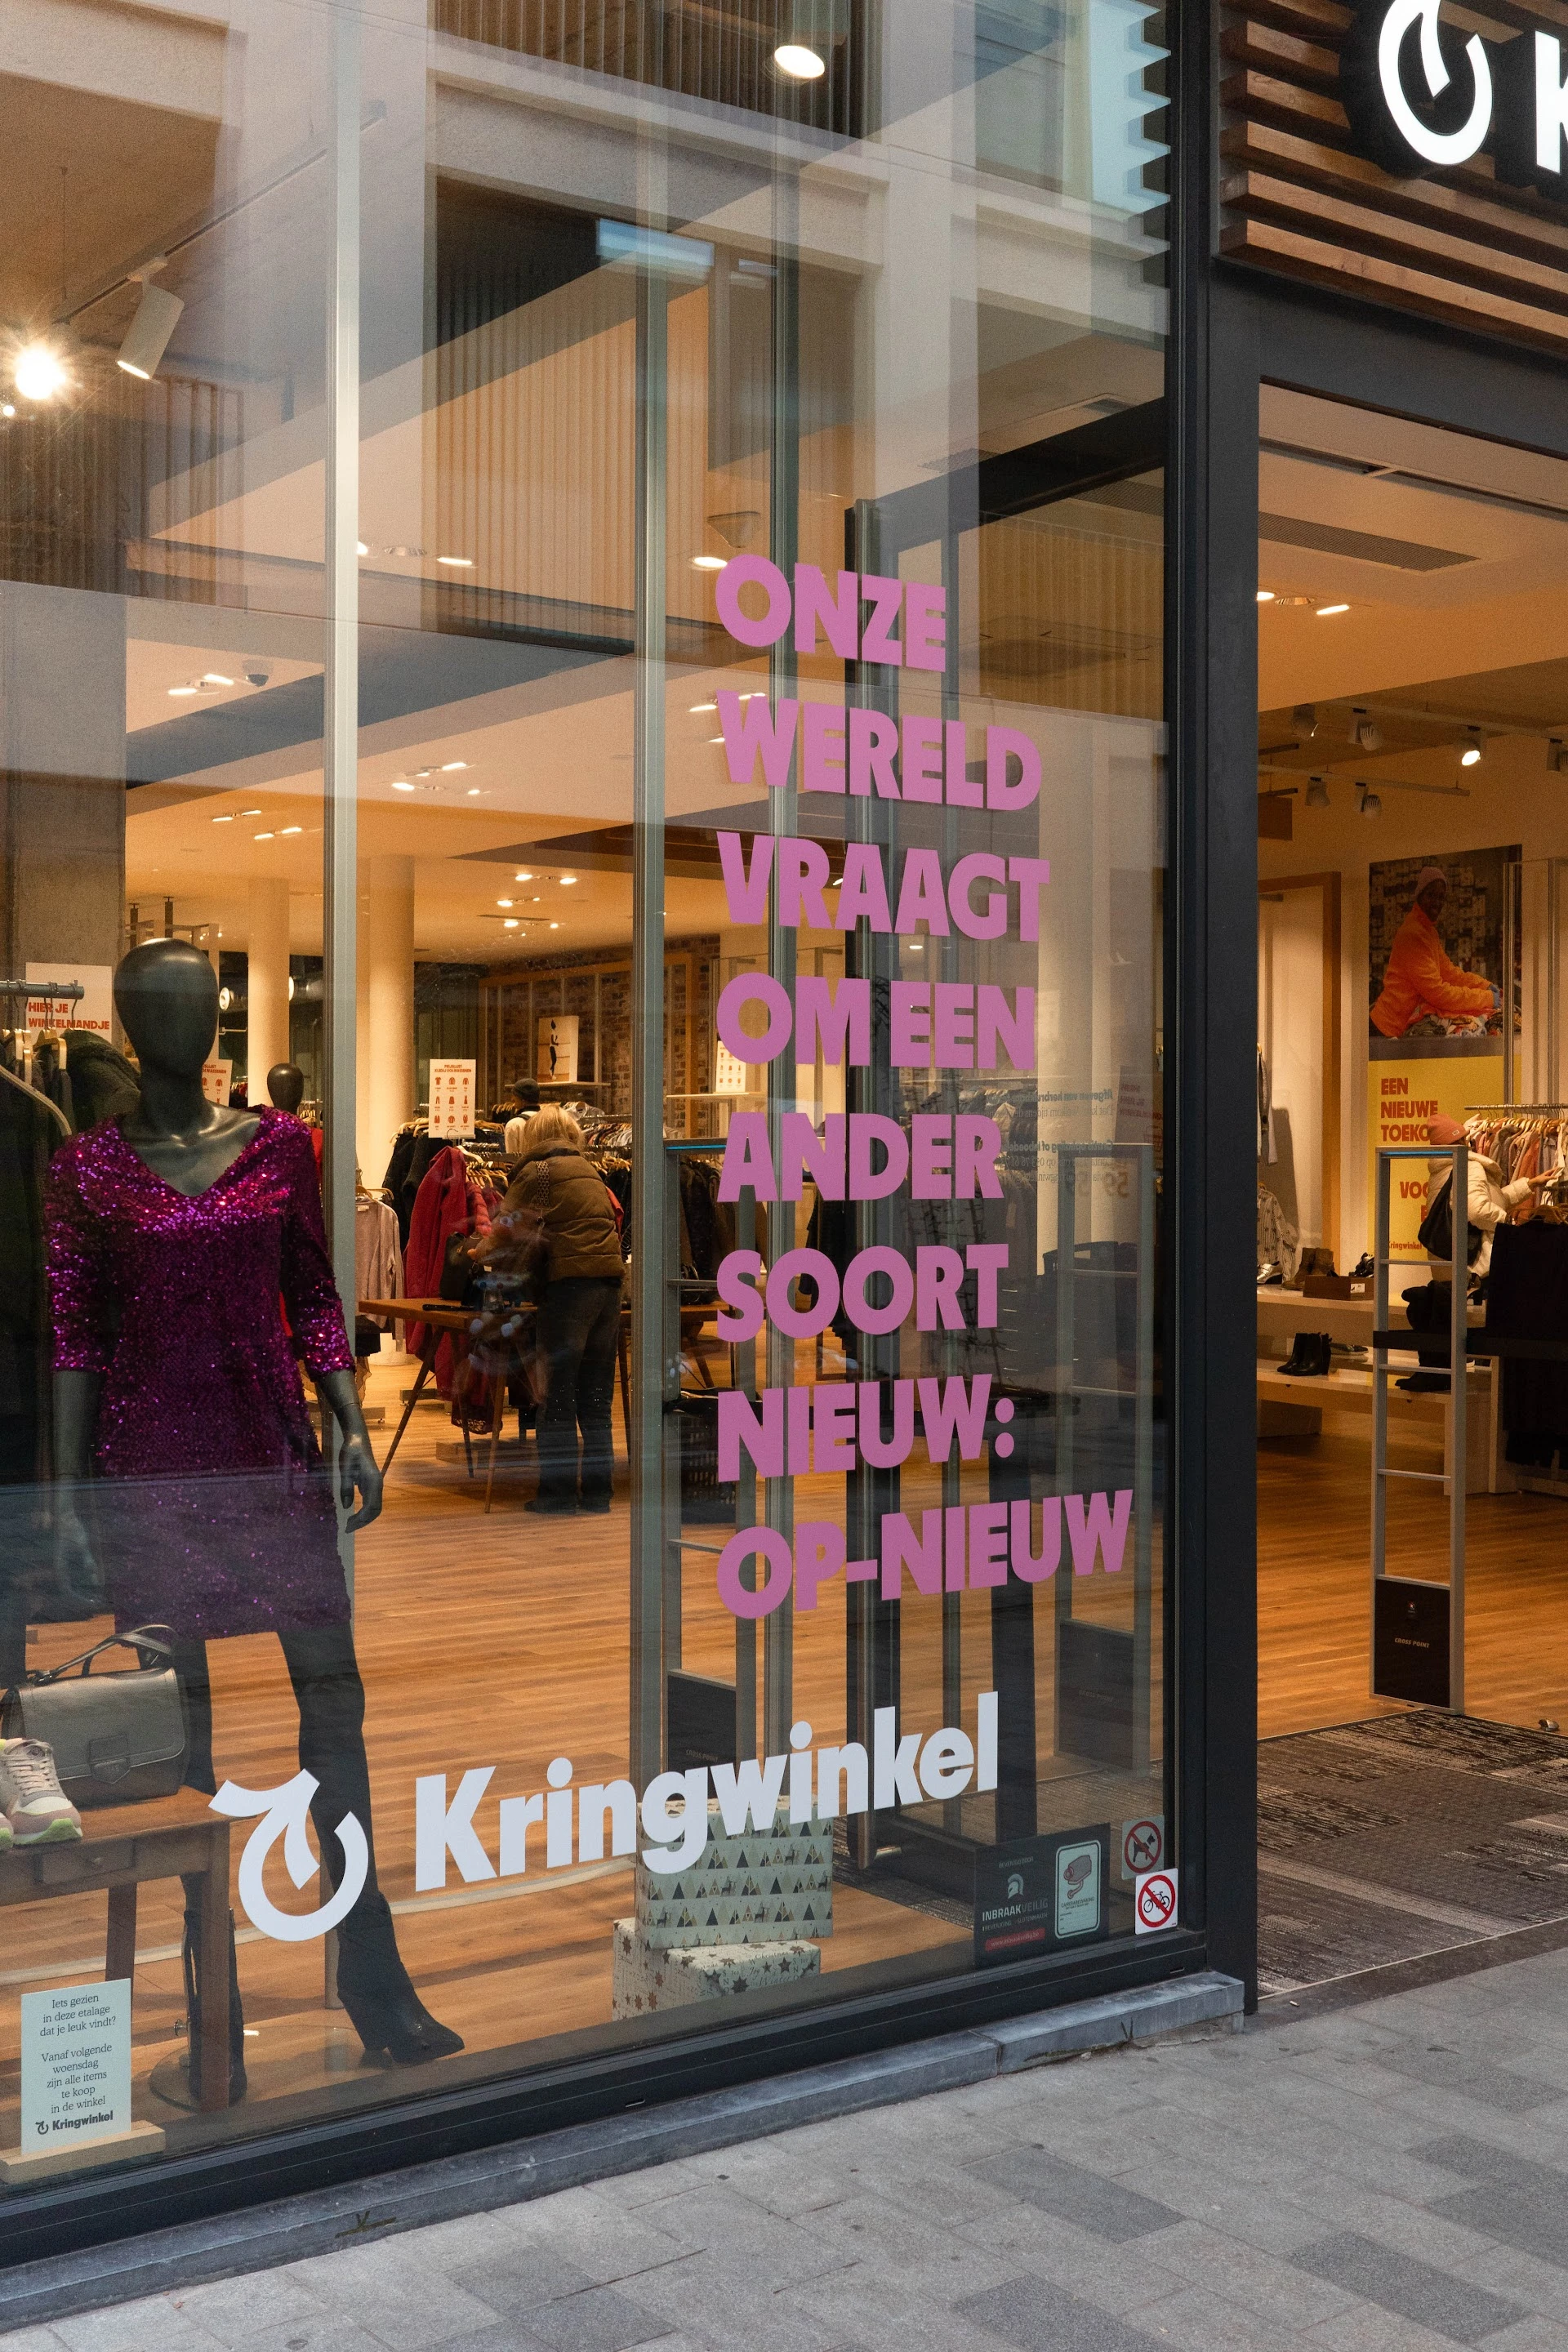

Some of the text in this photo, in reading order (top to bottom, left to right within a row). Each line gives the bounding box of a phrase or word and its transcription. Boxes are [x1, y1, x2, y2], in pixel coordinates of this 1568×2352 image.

[717, 555, 946, 671] ONZE
[717, 690, 1041, 810] WERELD
[717, 831, 1049, 942] VRAAGT
[29, 1002, 69, 1013] HIER JE
[29, 1018, 110, 1030] WINKELMANDJE
[717, 973, 1035, 1069] OM EEN
[1381, 1077, 1409, 1095] EEN
[1381, 1100, 1438, 1119] NIEUWE
[1381, 1124, 1430, 1143] TOEKO
[718, 1111, 1004, 1202] ANDER
[1400, 1181, 1428, 1199] VO
[717, 1244, 1009, 1342] SOORT
[718, 1374, 1014, 1482] NIEUW:
[717, 1489, 1133, 1619] OP-NIEUW
[1413, 1640, 1430, 1648] POINT
[415, 1690, 999, 1875] Kringwinkel
[52, 1995, 99, 2008] Iets gezien
[43, 2006, 110, 2023] in deze etalage
[40, 2016, 116, 2037] dat je leuk vindt?
[42, 2043, 113, 2062] Vanaf volgende
[53, 2060, 99, 2074] woensdag
[47, 2071, 107, 2089] zijn alle items
[73, 2087, 96, 2097] koop
[51, 2096, 106, 2114] in de winkel
[52, 2110, 114, 2131] Kringwinkel
